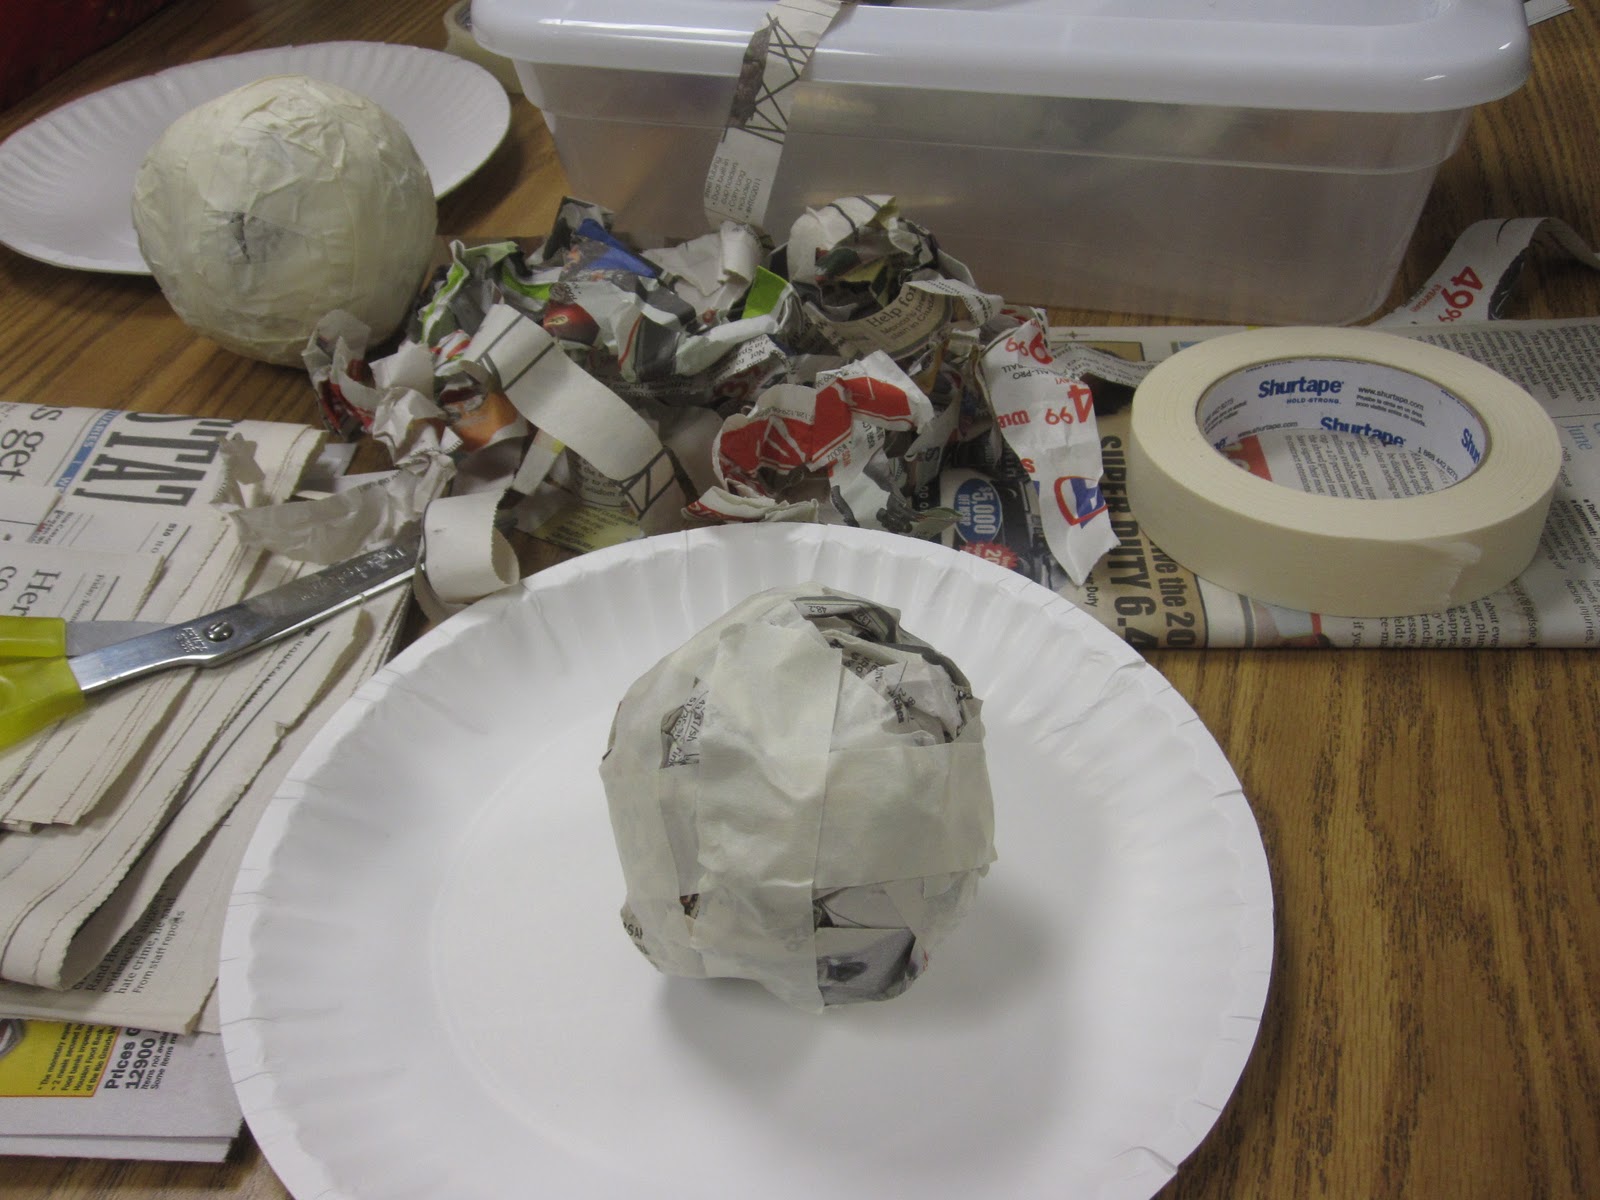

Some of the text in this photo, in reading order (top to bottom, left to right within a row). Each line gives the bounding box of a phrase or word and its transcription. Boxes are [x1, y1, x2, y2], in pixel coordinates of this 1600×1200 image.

[866, 307, 902, 328] Help
[1258, 377, 1342, 399] Shurtape
[1320, 416, 1406, 447] Shurtape
[1560, 424, 1593, 450] June
[0, 428, 44, 482] get
[972, 487, 996, 534] $5,000
[1574, 503, 1595, 537] Comment:
[1107, 521, 1152, 589] DUTY
[1084, 587, 1099, 607] Duty
[1158, 577, 1187, 607] the
[1353, 621, 1364, 630] if
[1460, 615, 1471, 634] you
[1484, 601, 1499, 624] about
[116, 970, 136, 996] hate
[132, 935, 157, 971] crime,
[153, 921, 165, 935] he
[133, 912, 187, 995] From staff reports
[105, 1040, 135, 1091] Prices
[126, 1038, 156, 1090] 12900
[141, 1054, 161, 1089] Items not
[151, 1046, 174, 1089] Some items
